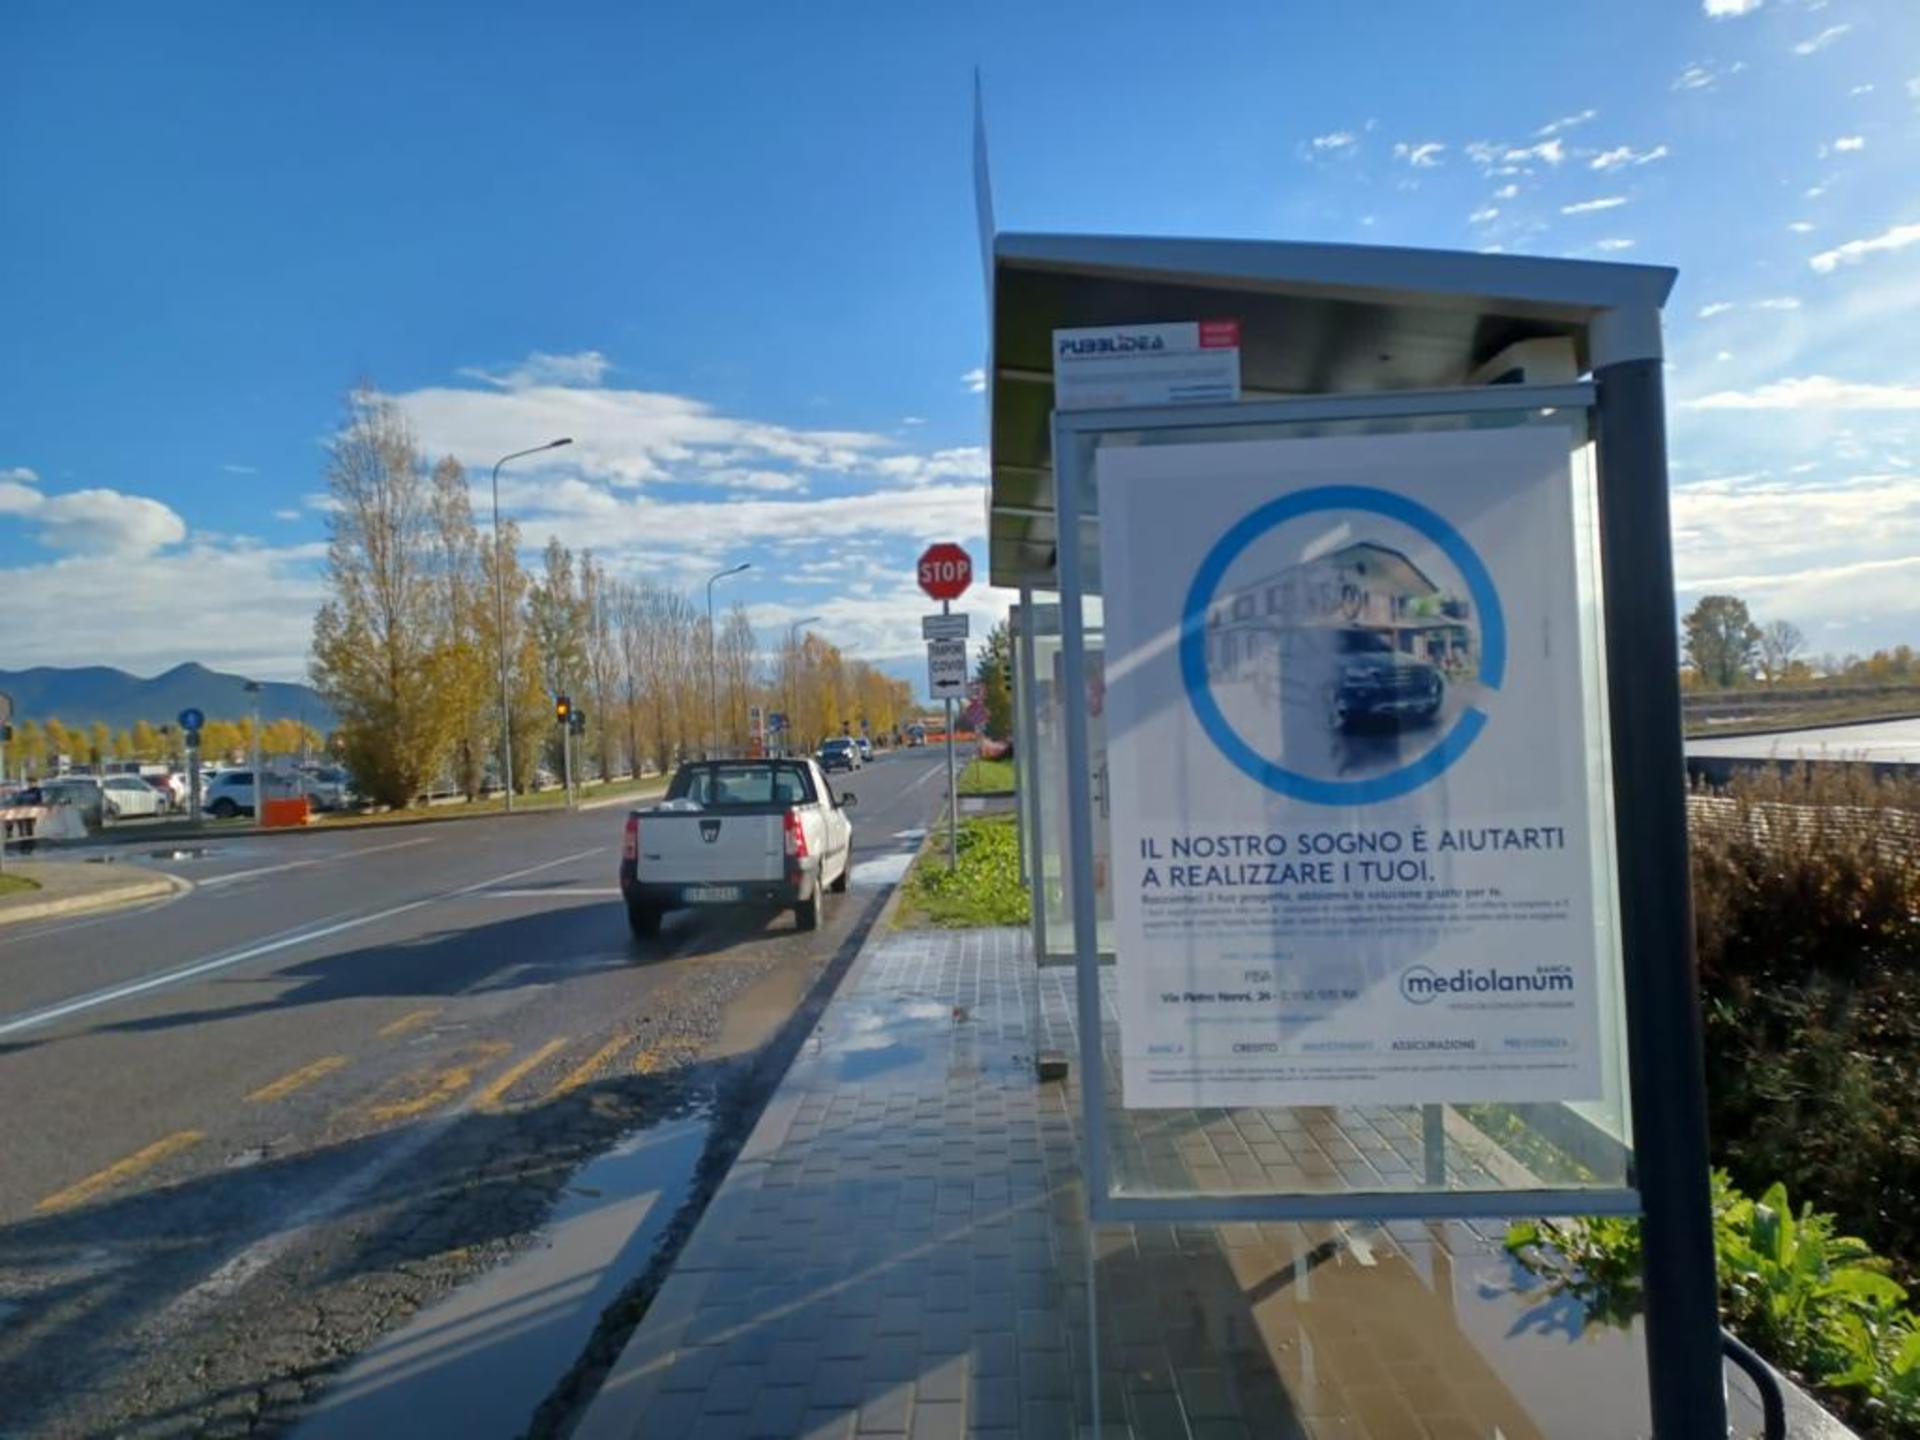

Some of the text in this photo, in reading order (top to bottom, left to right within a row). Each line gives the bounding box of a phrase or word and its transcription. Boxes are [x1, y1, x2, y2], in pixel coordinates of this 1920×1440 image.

[920, 560, 968, 583] STOP
[1140, 825, 1565, 859] IL NOSTRO SOGNO È AIUTARTI
[1141, 859, 1436, 887] A REALIZZARE I TUOI.
[1407, 967, 1575, 994] mediolanum
